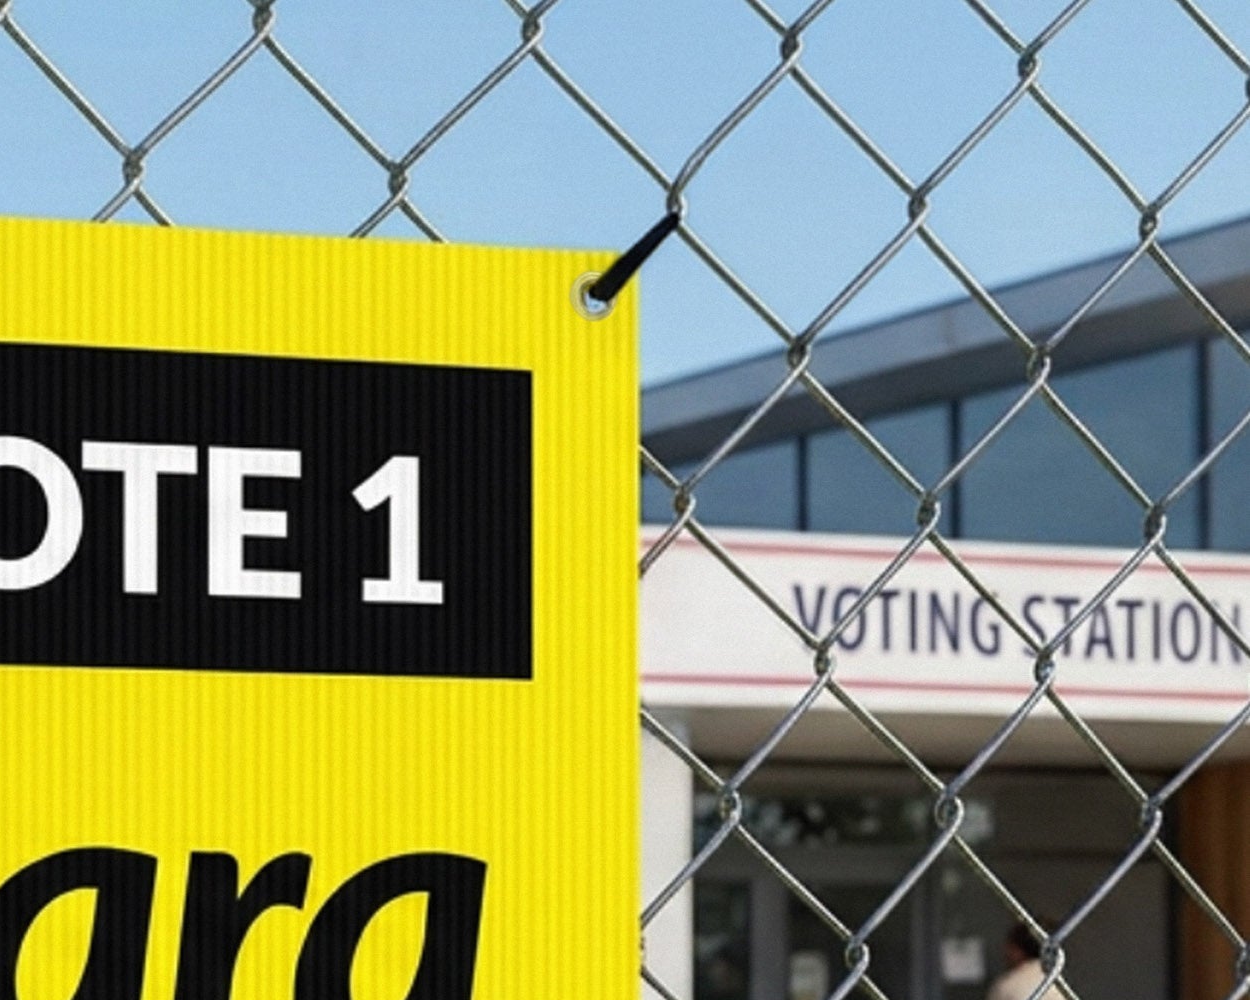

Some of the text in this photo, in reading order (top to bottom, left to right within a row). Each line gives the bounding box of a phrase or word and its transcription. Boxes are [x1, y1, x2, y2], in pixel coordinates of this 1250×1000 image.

[351, 455, 444, 605] 1
[792, 583, 1243, 664] VOTING STATION
